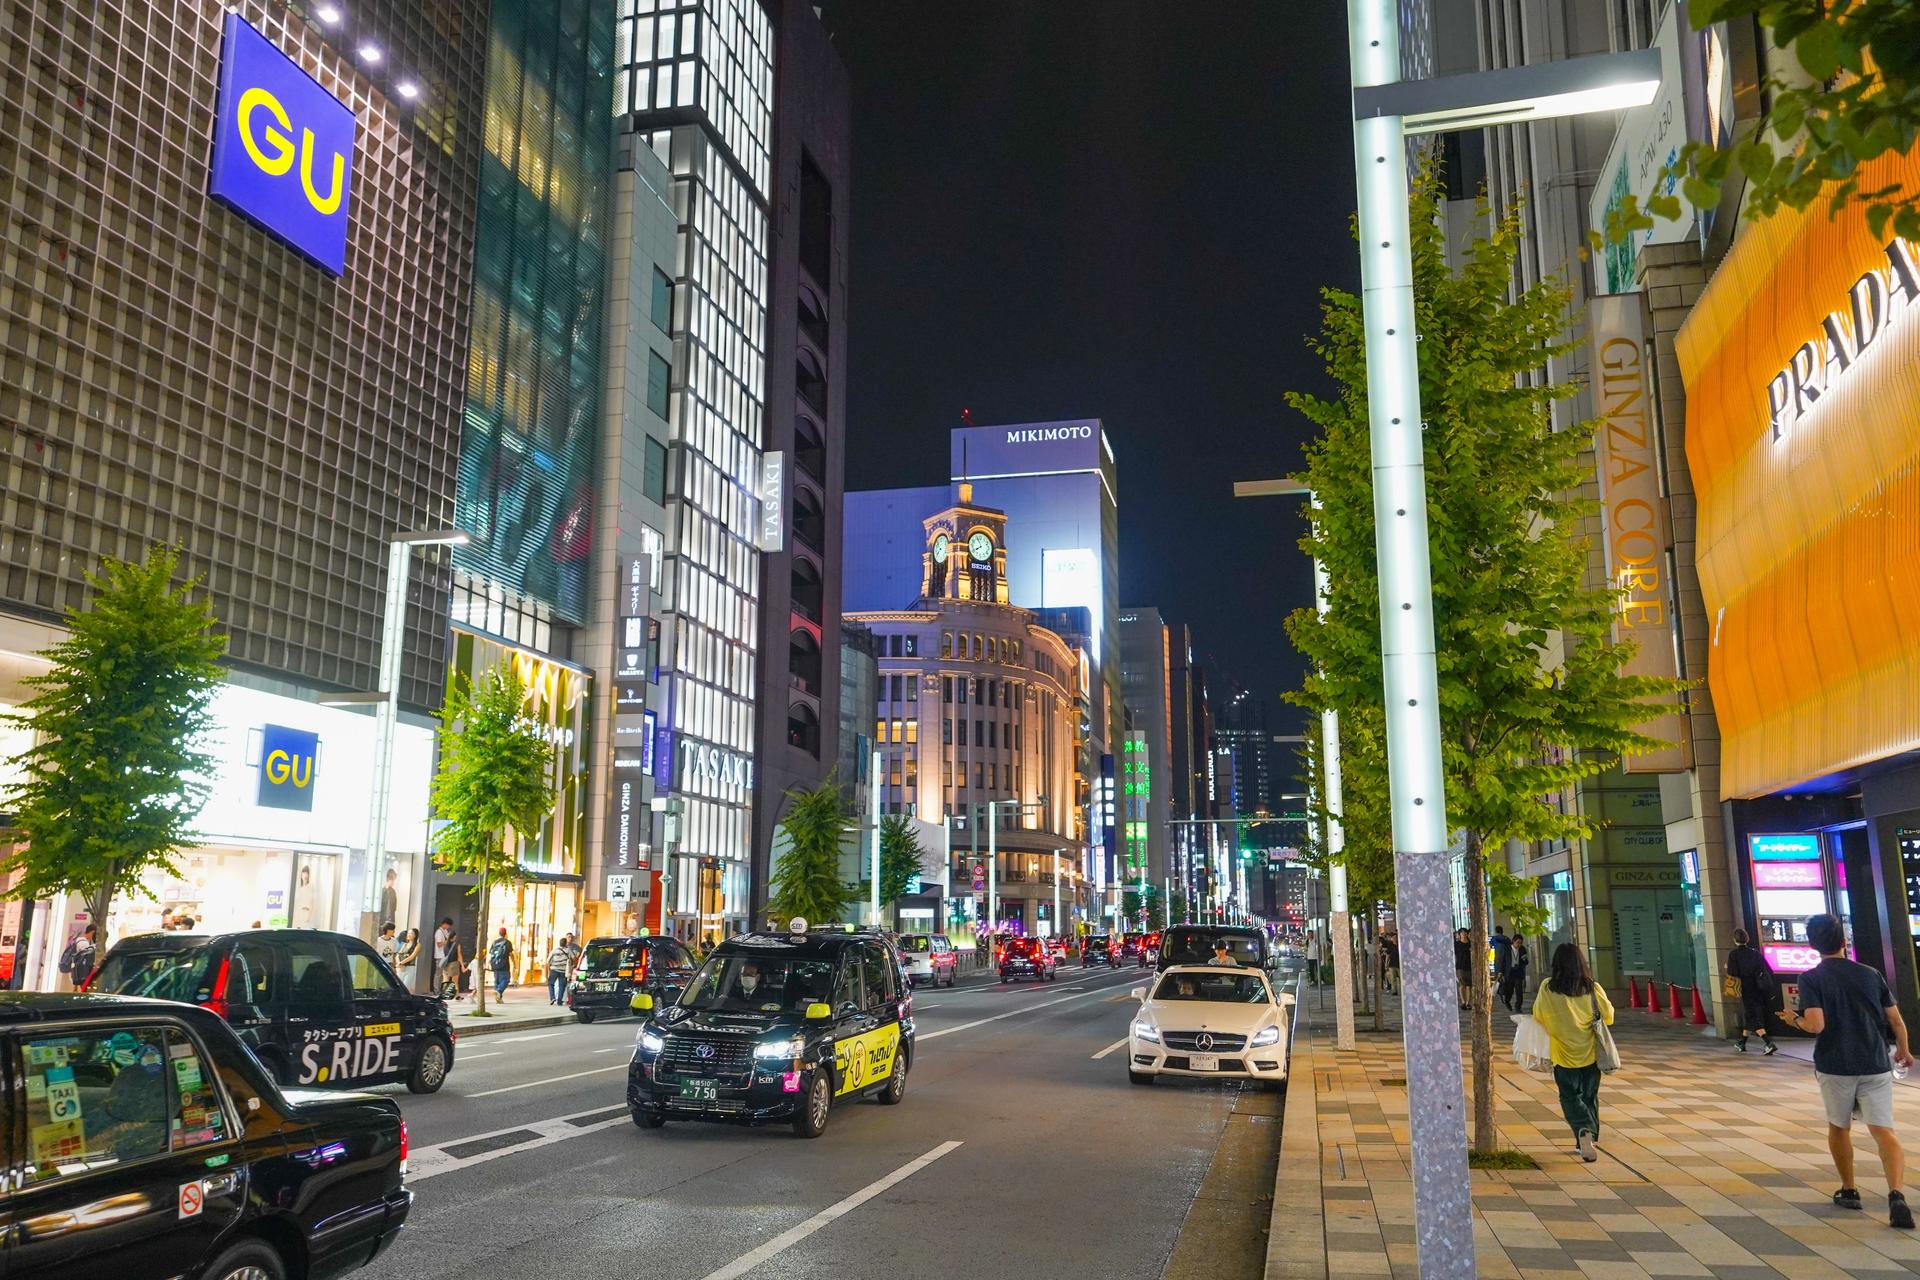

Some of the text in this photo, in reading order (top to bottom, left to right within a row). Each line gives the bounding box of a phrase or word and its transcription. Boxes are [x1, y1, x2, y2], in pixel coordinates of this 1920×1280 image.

[1658, 100, 1673, 144] 430
[236, 87, 346, 216] GU
[1766, 236, 1920, 445] PRADA
[1007, 426, 1093, 443] MIKIMOTO
[1600, 337, 1663, 629] GINZA CORE
[764, 462, 781, 541] TASAKI
[971, 562, 992, 571] SEIKO
[266, 748, 313, 789] GU
[680, 737, 754, 790] TASAKI
[618, 783, 631, 866] GINZA DAIKOKUYA
[1624, 836, 1663, 846] CITY CLUB OF
[610, 877, 629, 885] TAXI
[1616, 872, 1654, 881] GINZA
[267, 894, 283, 905] GU
[1776, 948, 1822, 965] ECC
[303, 1026, 362, 1043] タクシーアプリ
[298, 1036, 402, 1085] S.RIDE
[50, 1088, 75, 1100] TAXI
[54, 1100, 77, 1117] GO
